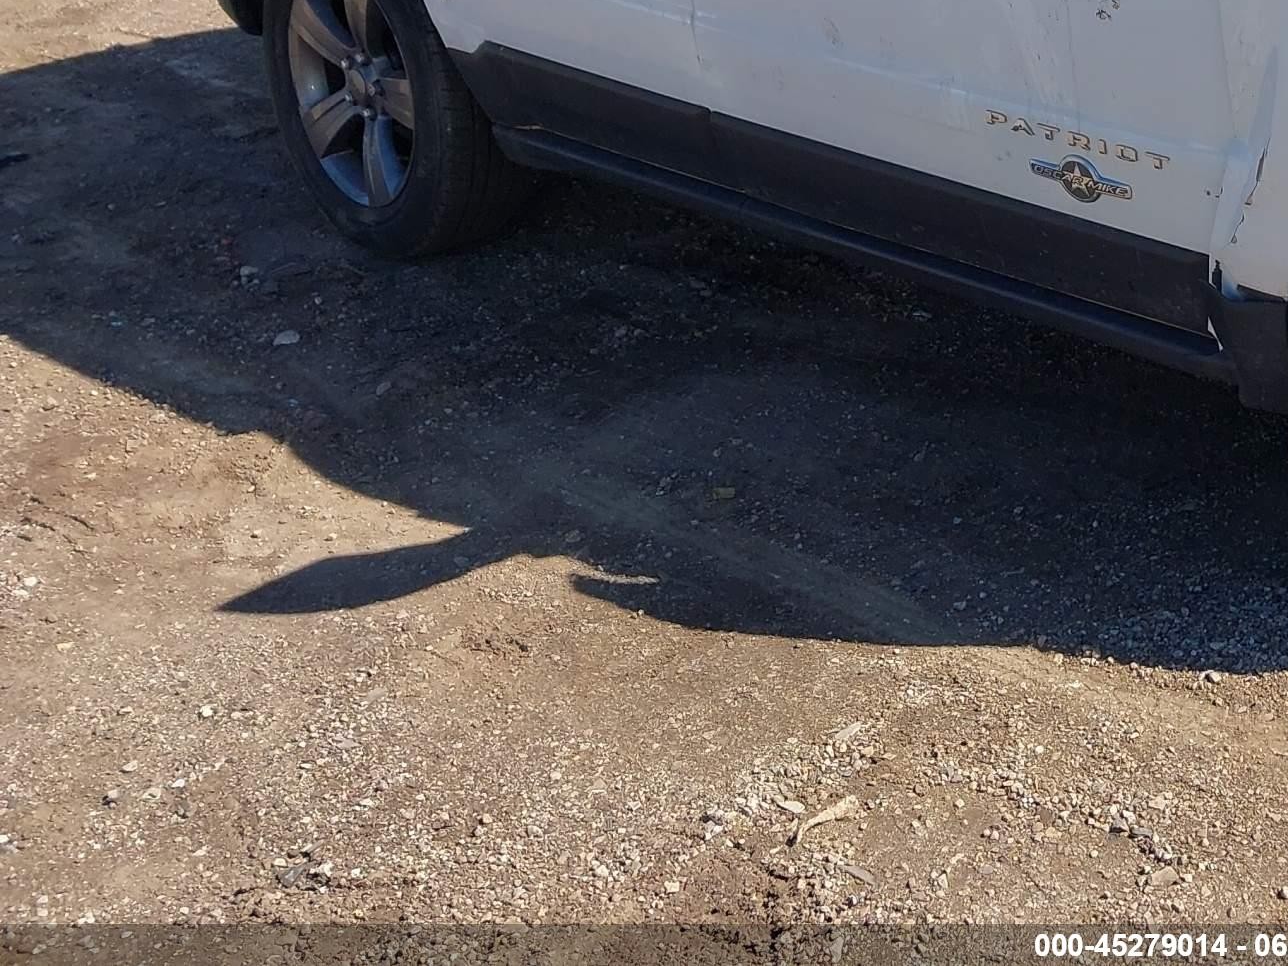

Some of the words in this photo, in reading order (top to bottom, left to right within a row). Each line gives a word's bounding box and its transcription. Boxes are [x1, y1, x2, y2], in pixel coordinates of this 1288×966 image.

[985, 108, 1170, 170] PATRIOT
[1033, 165, 1086, 186] OSCAR
[1087, 179, 1128, 196] MIKE
